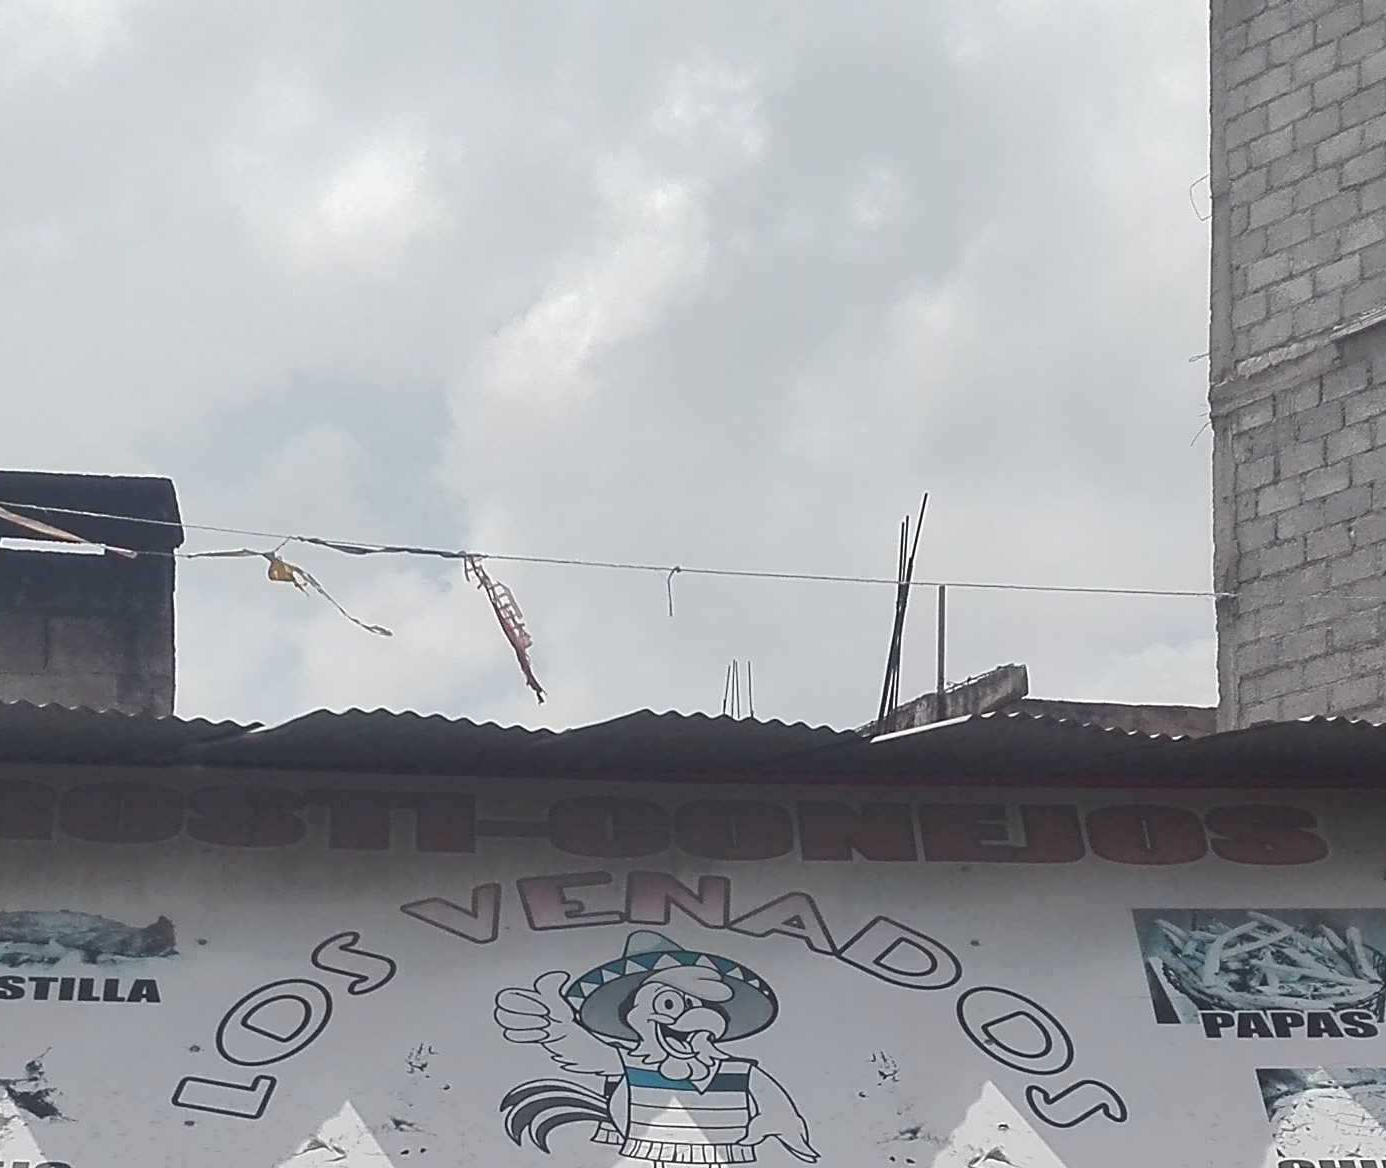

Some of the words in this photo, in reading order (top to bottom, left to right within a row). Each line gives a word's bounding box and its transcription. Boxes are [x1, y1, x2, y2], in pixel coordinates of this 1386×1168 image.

[171, 931, 396, 1119] LOS
[401, 870, 1127, 1127] VENADOS
[1204, 1010, 1379, 1039] PAPAS
